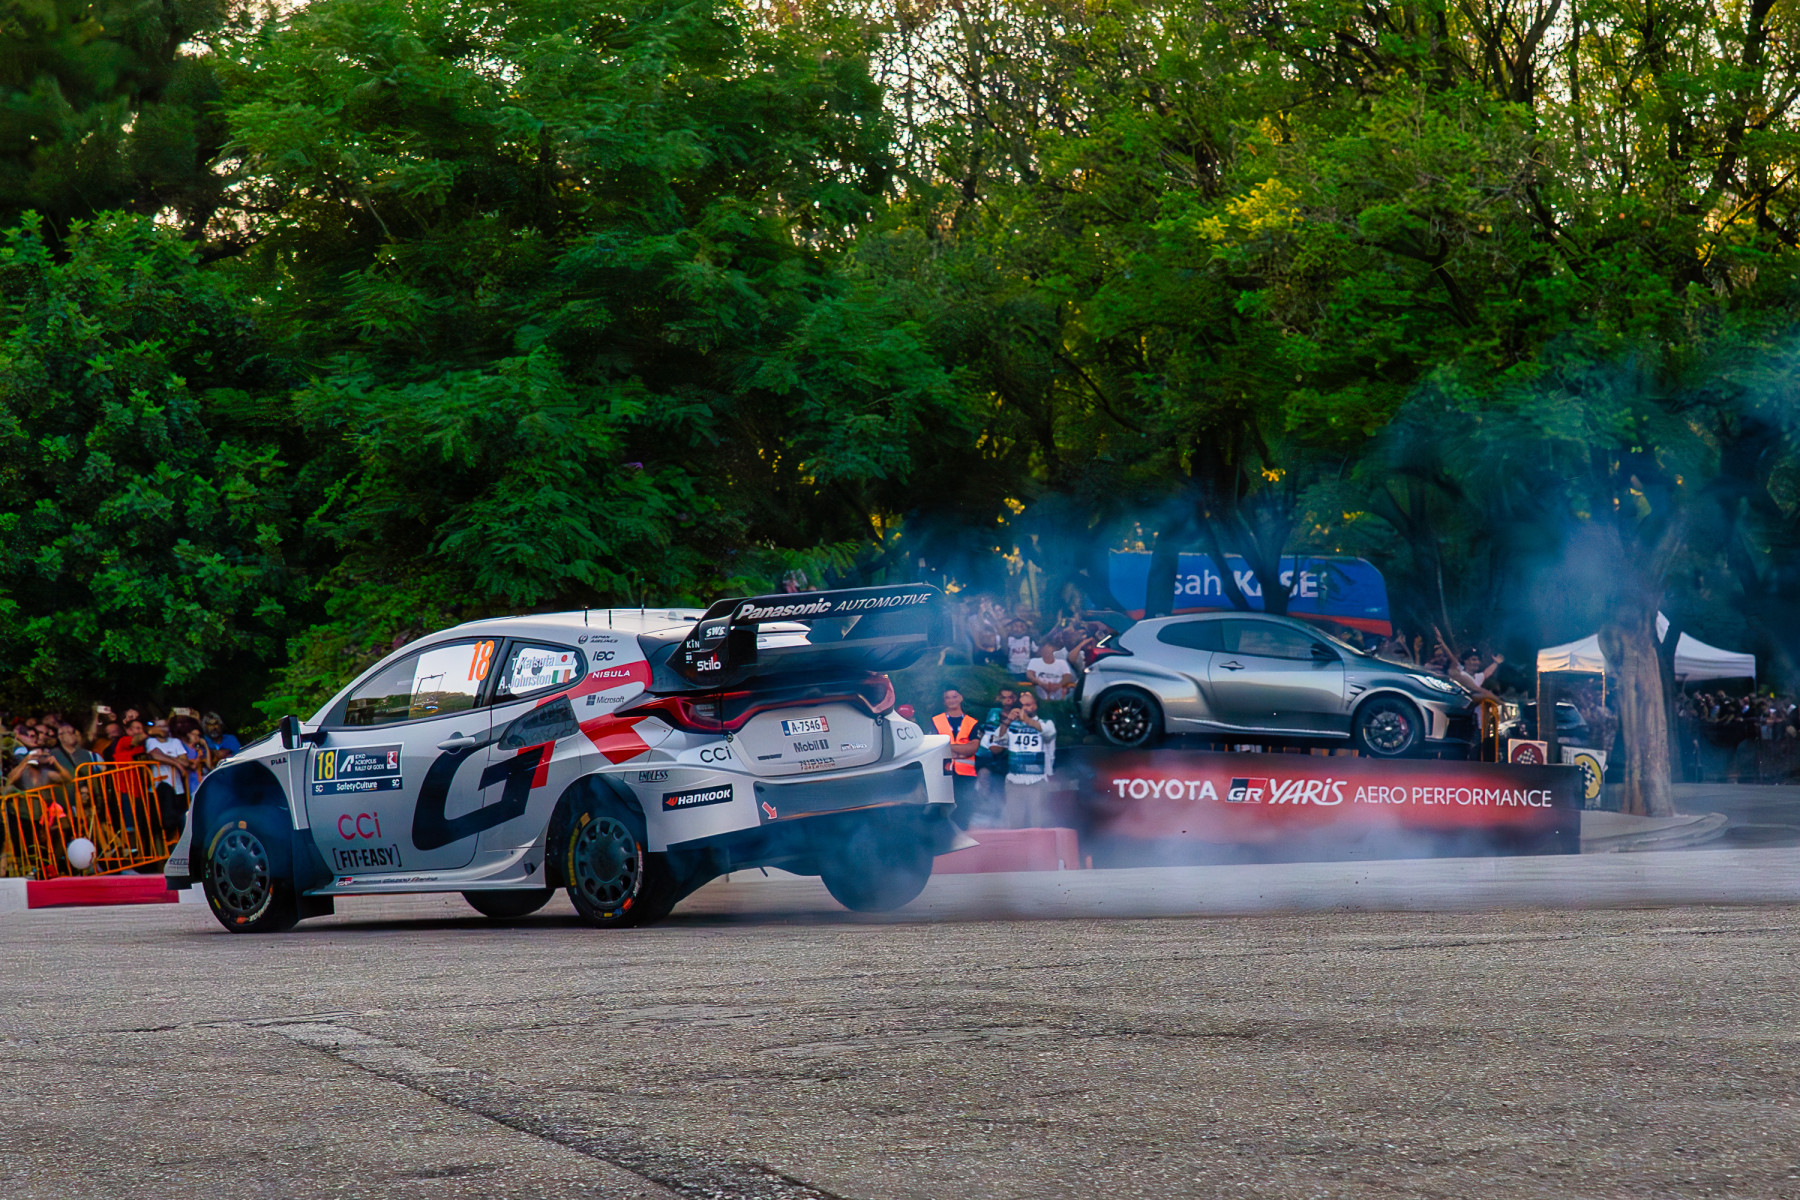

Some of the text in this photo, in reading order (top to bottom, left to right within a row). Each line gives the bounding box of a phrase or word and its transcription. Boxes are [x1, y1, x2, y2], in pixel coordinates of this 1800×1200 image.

[735, 593, 932, 620] Panasonic AUTOMOTIVE
[468, 640, 495, 681] 18
[697, 656, 722, 672] Stilo
[592, 670, 630, 679] NISULA
[597, 696, 625, 704] Microsoft
[792, 719, 821, 733] A-7546
[700, 746, 732, 763] CCi
[793, 740, 820, 753] Mobil
[318, 751, 335, 780] 18
[336, 781, 378, 791] SafetyCulture
[1113, 778, 1218, 801] TOYOTA
[1354, 785, 1407, 804] AERO
[1412, 786, 1552, 808] PERFORMANCE
[337, 811, 382, 840] CCi
